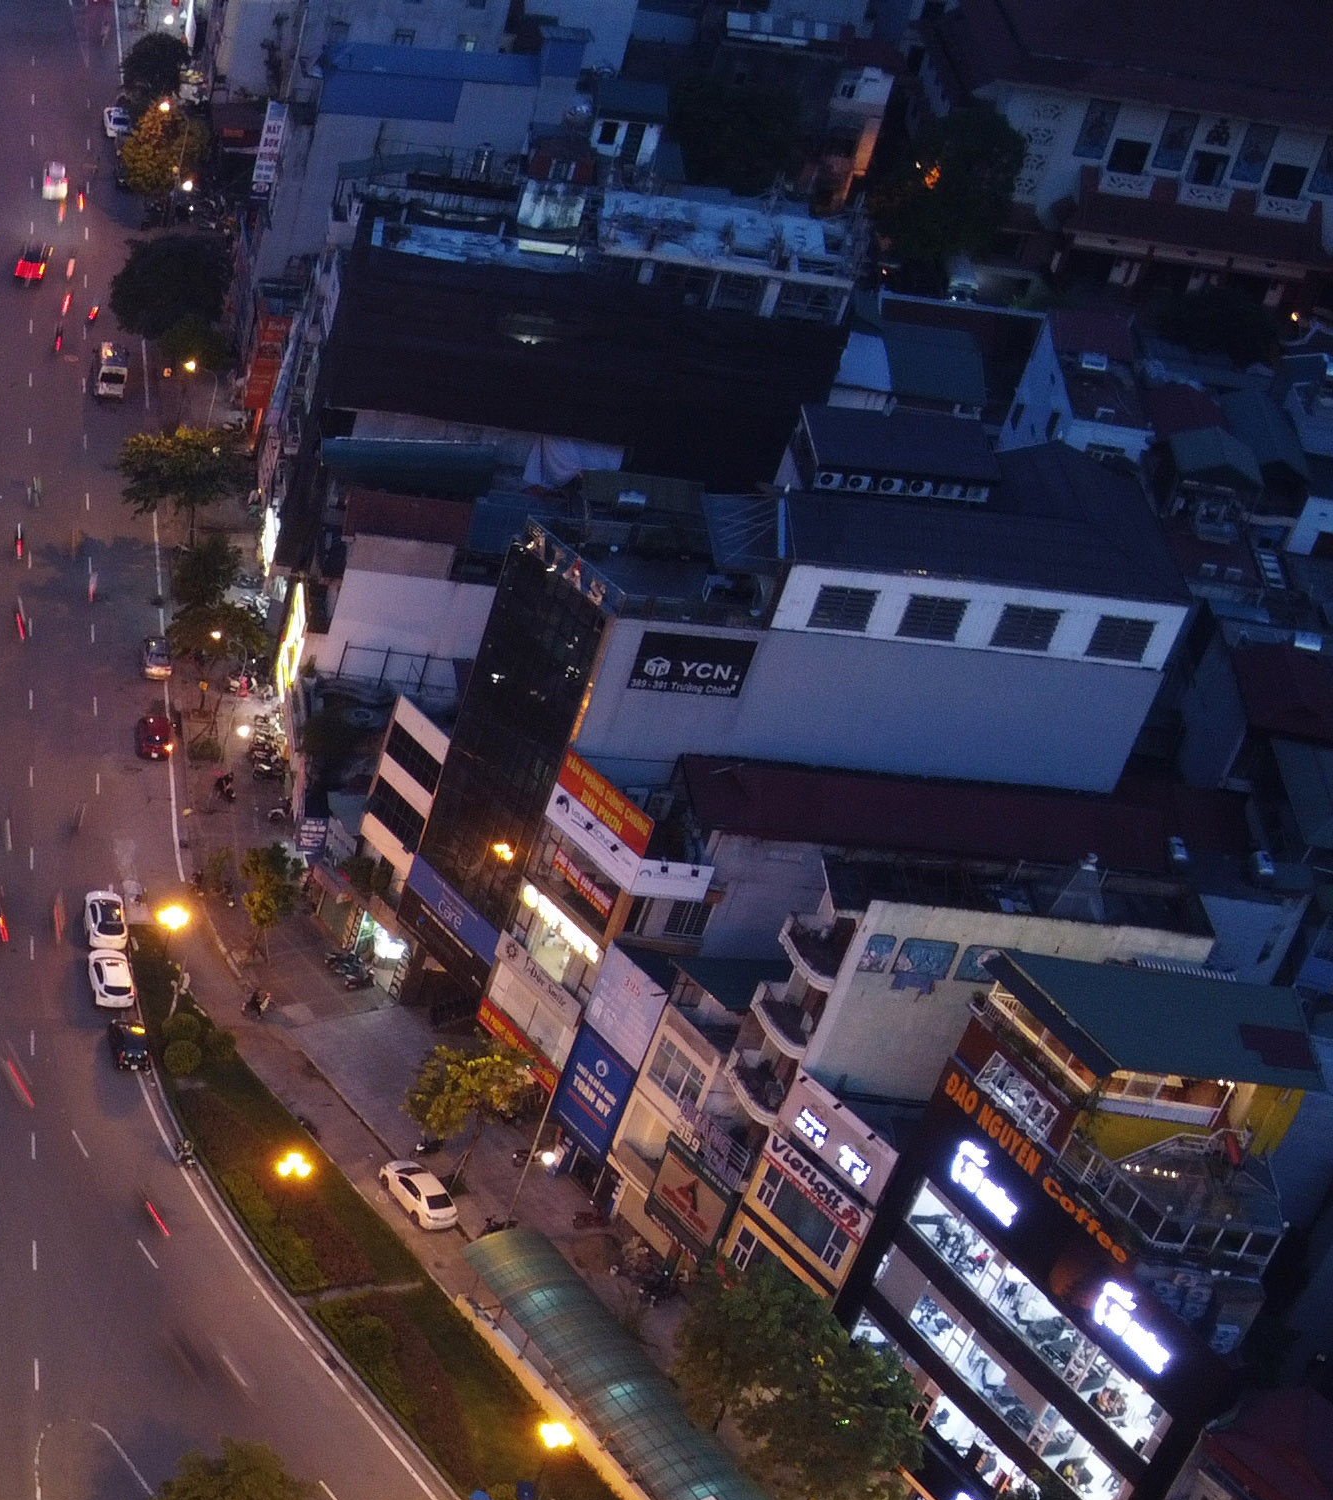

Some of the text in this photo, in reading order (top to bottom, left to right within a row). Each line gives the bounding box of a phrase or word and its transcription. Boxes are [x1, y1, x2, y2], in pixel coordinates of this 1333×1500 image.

[681, 661, 732, 681] YCN
[765, 1135, 846, 1213] Vietlott
[945, 1072, 978, 1115] ĐÀO
[1043, 1176, 1127, 1264] Coffee
